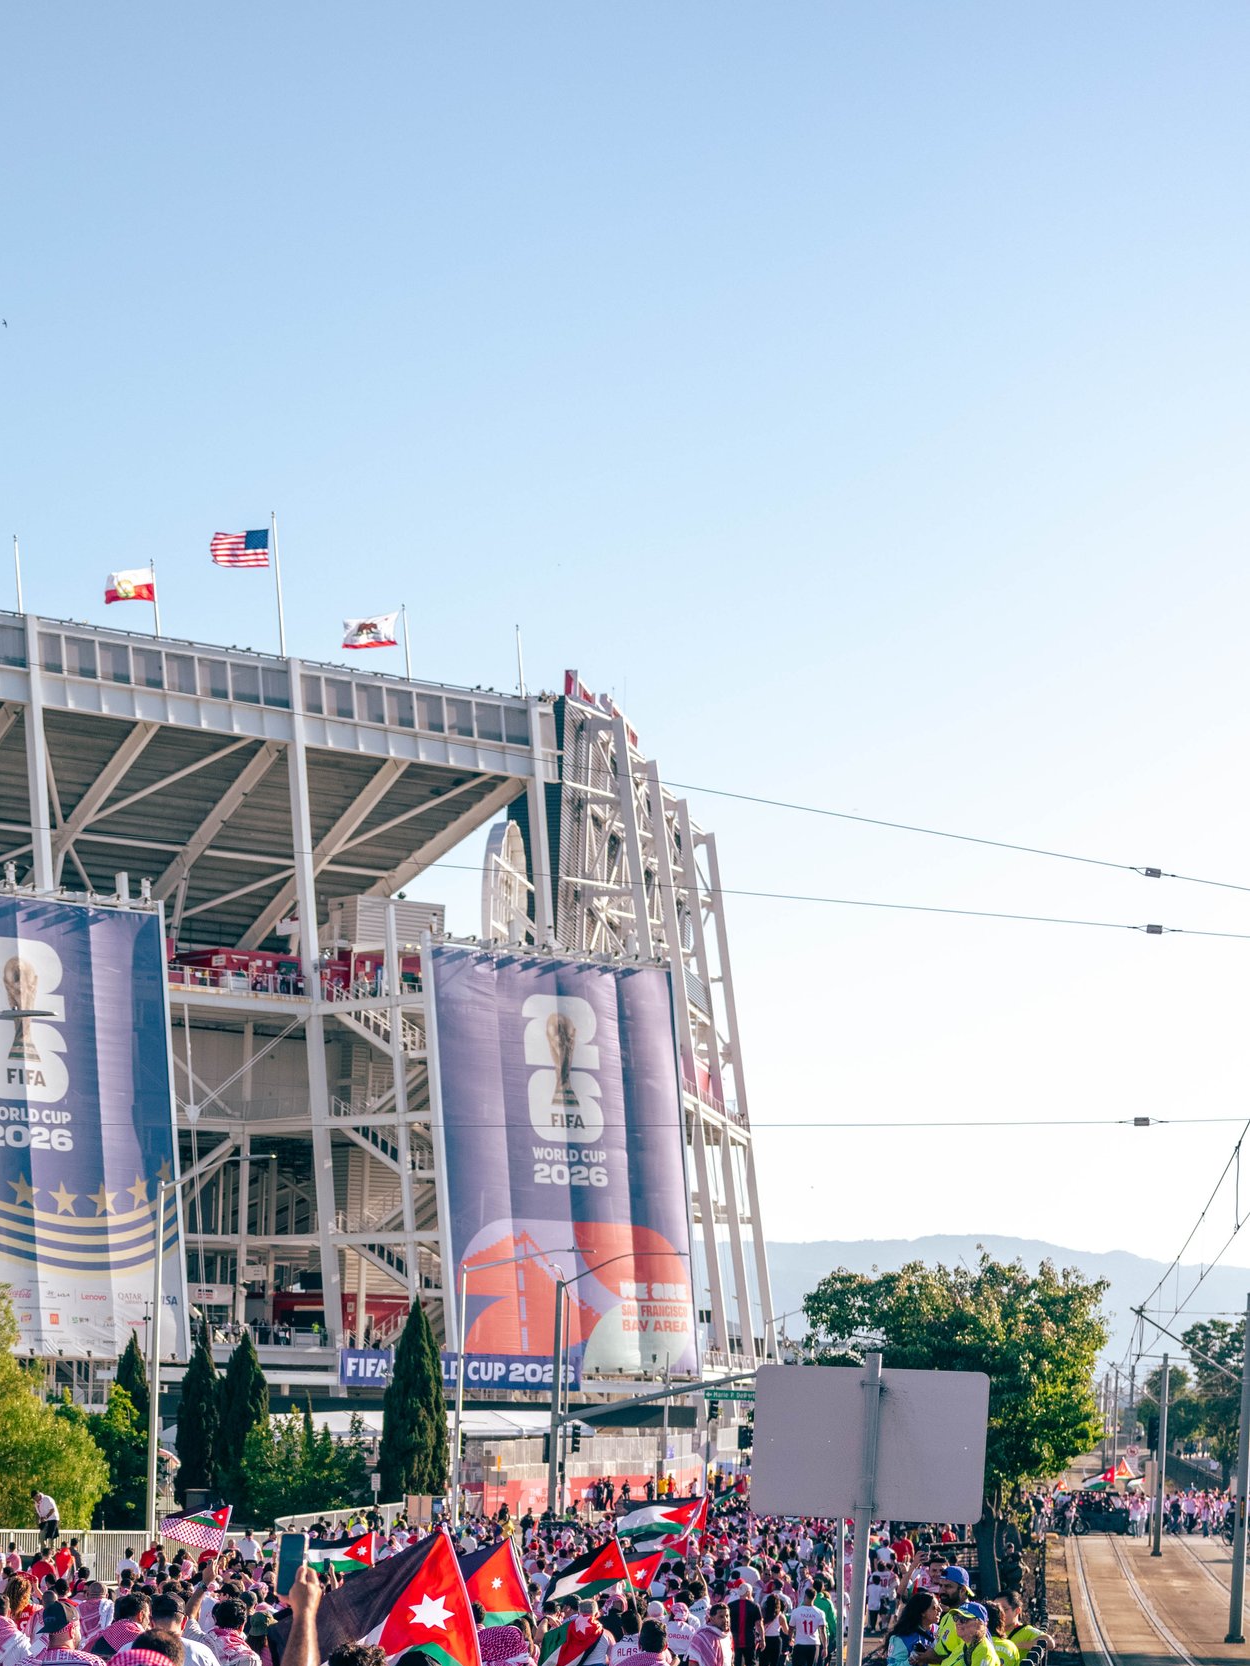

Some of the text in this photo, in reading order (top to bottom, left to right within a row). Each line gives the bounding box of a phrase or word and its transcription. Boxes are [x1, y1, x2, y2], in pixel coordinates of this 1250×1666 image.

[7, 1068, 46, 1087] FIFA
[41, 1110, 72, 1124] CUP
[551, 1113, 585, 1129] FIFA
[532, 1146, 607, 1163] WORLD CUP
[533, 1163, 609, 1188] 2026
[81, 1293, 107, 1301] Lenovo
[117, 1292, 142, 1300] QATAR
[161, 1296, 178, 1306] ISA
[621, 1304, 688, 1318] SAN FRANCISCO
[622, 1319, 689, 1333] BAY AREA
[467, 1361, 506, 1381] CUP
[802, 1620, 813, 1635] 11
[668, 1632, 690, 1640] ORDAN
